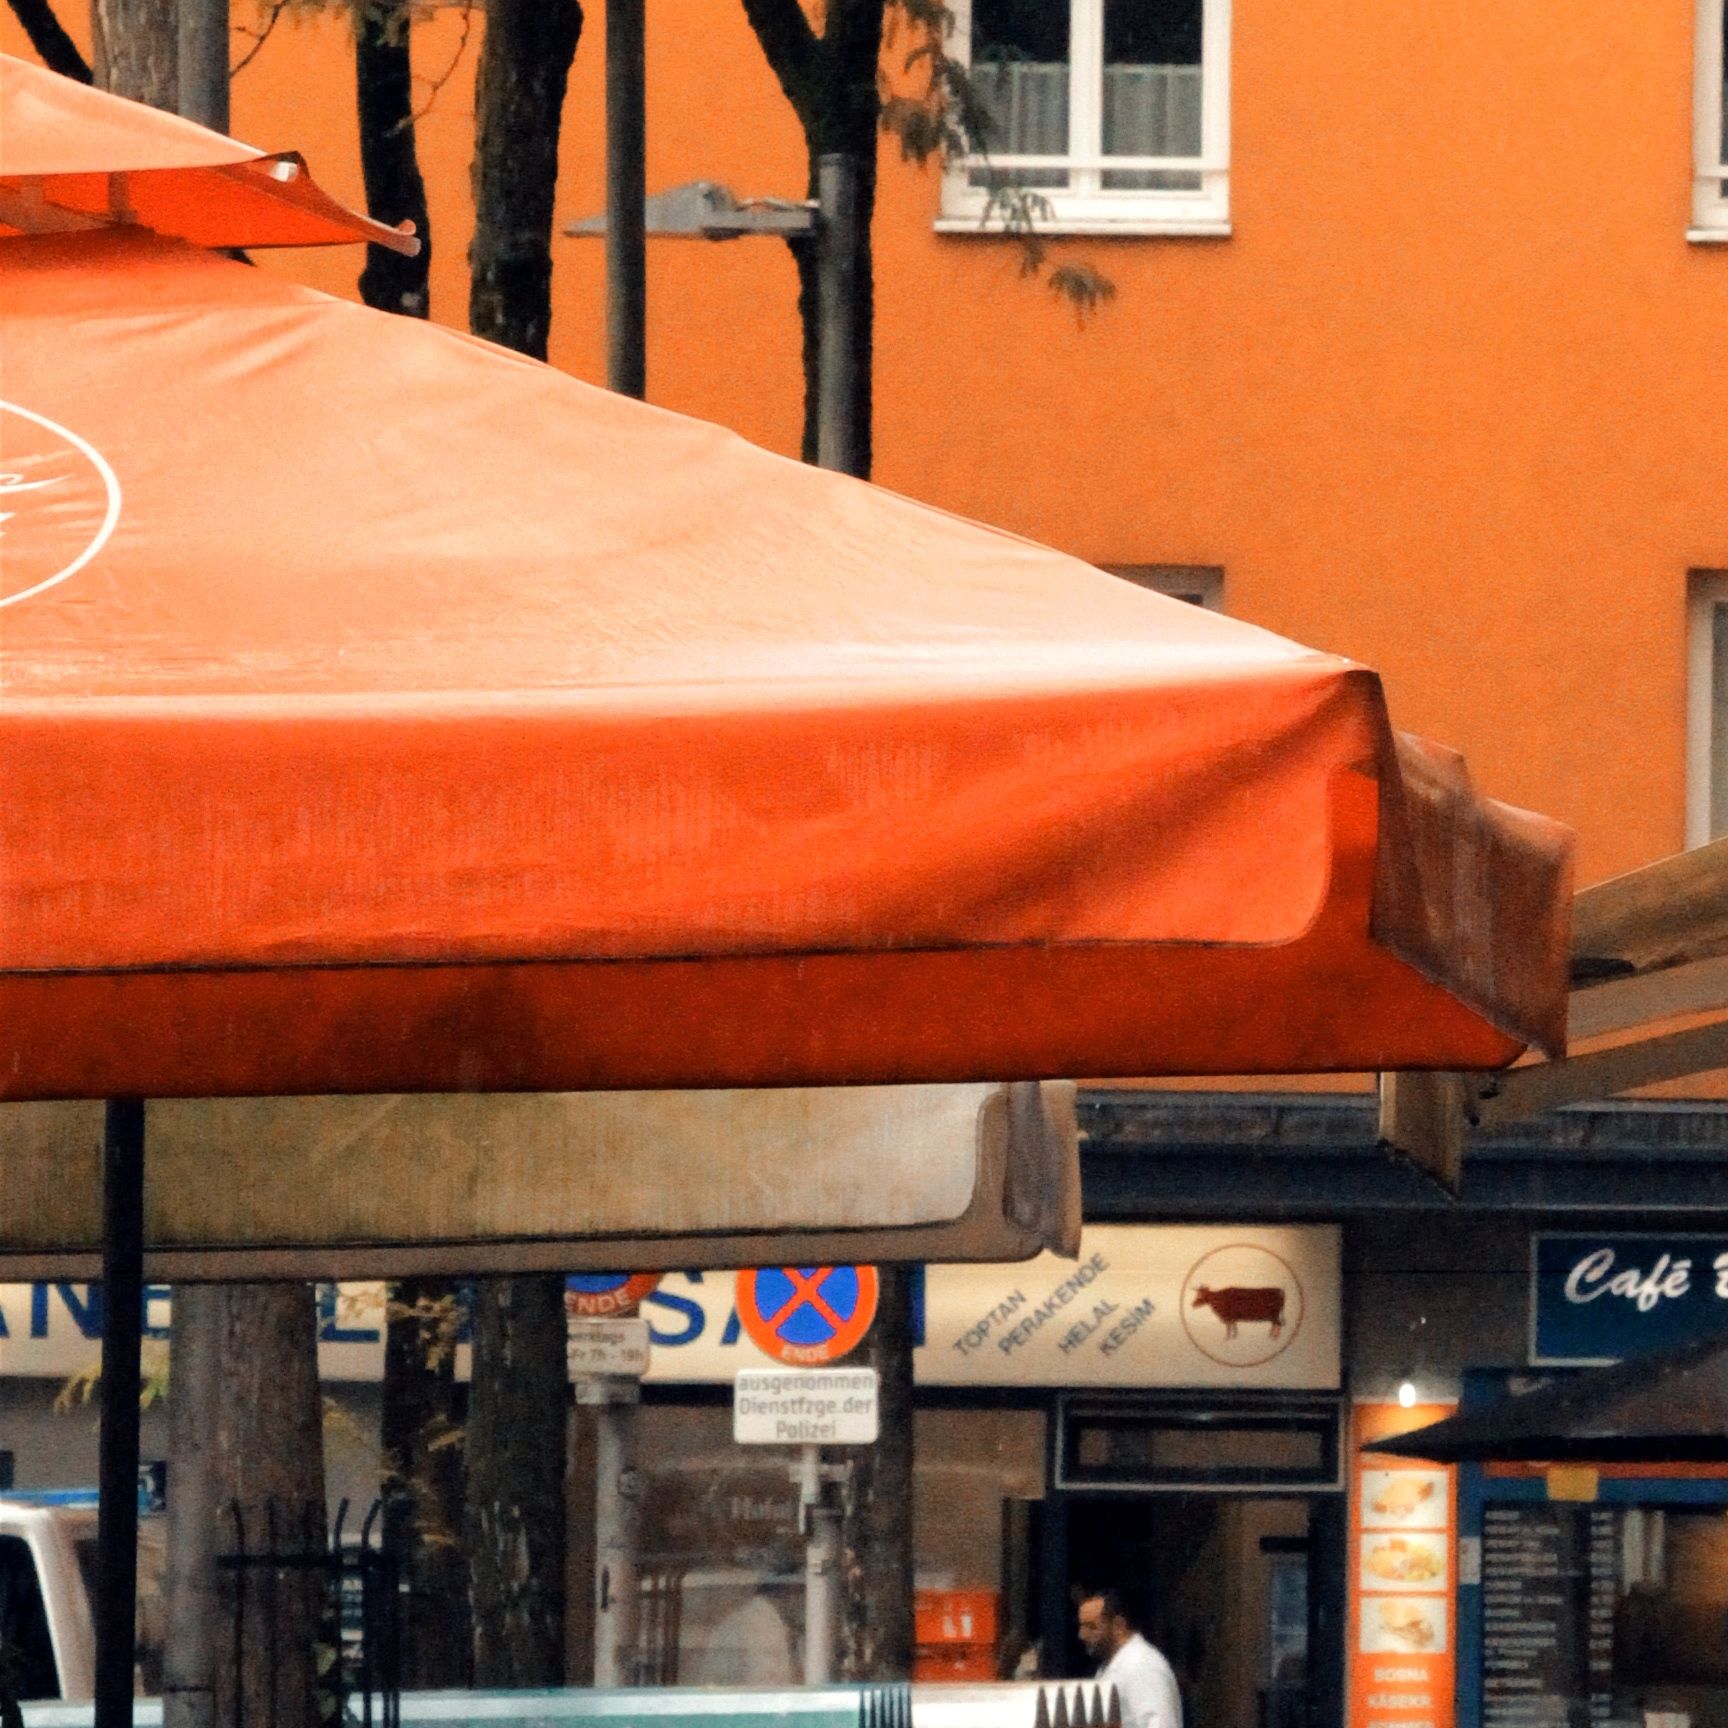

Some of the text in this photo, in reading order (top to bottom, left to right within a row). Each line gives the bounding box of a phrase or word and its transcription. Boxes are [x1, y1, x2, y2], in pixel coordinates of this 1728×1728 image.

[998, 1252, 1111, 1356] PERAKENDE
[1563, 1248, 1693, 1312] Café
[953, 1289, 1028, 1356] TOPTAN
[1058, 1299, 1120, 1354] HELAL
[738, 1376, 874, 1394] ausgenommen
[775, 1421, 837, 1439] Polizei
